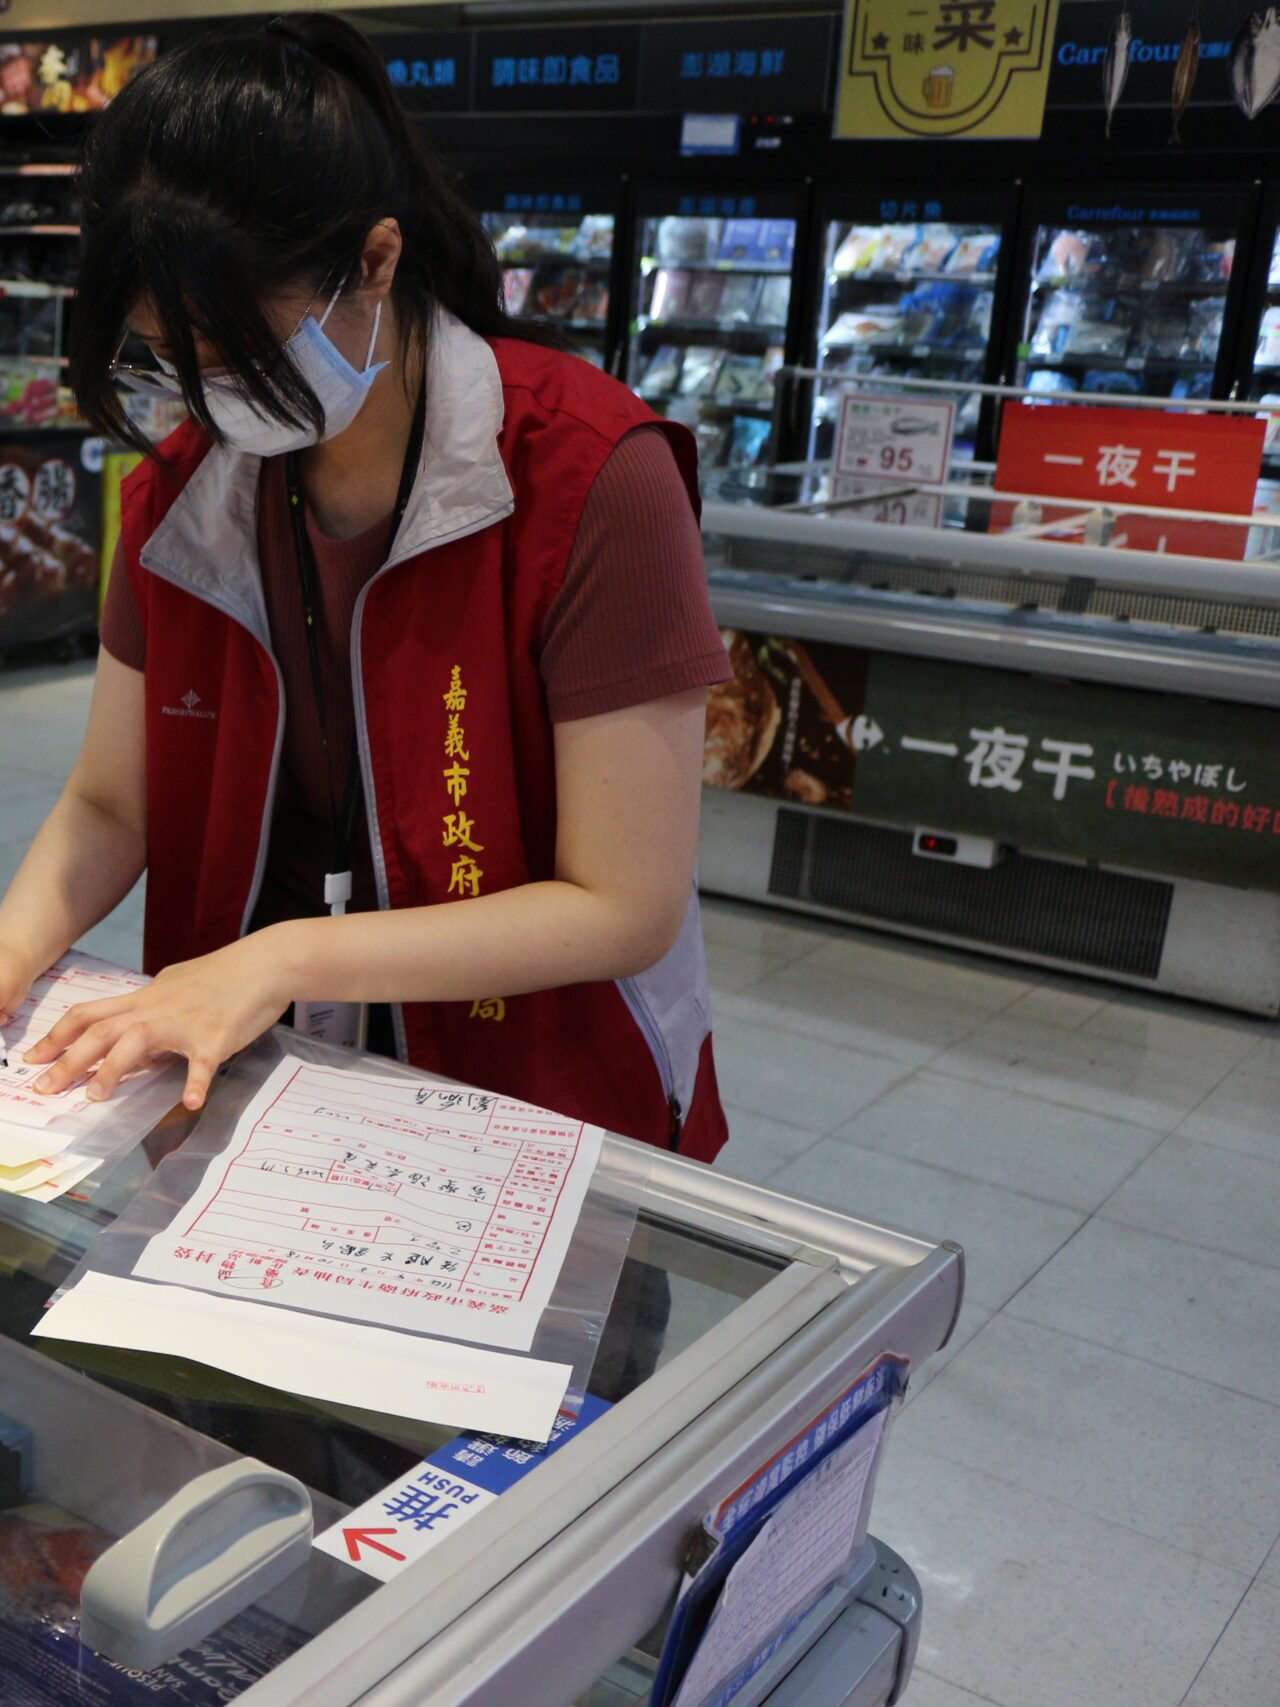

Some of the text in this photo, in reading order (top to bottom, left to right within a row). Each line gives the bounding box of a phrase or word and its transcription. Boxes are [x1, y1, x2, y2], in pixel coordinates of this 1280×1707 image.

[903, 12, 927, 55] 一味
[932, 0, 996, 52] 菜
[492, 54, 620, 88] 調味即食品
[680, 48, 786, 79] 澎湖海鮮
[1057, 38, 1180, 66] Carfour
[879, 445, 914, 473] 95
[1044, 445, 1197, 493] 一夜干
[900, 726, 1097, 801] 一夜干
[1113, 752, 1248, 793] いちやぼし
[174, 1247, 217, 1264] 封袋
[292, 1266, 511, 1315] 嘉義市政府衛生局抽查
[381, 1483, 459, 1533] 推
[418, 1470, 480, 1506] PUSH
